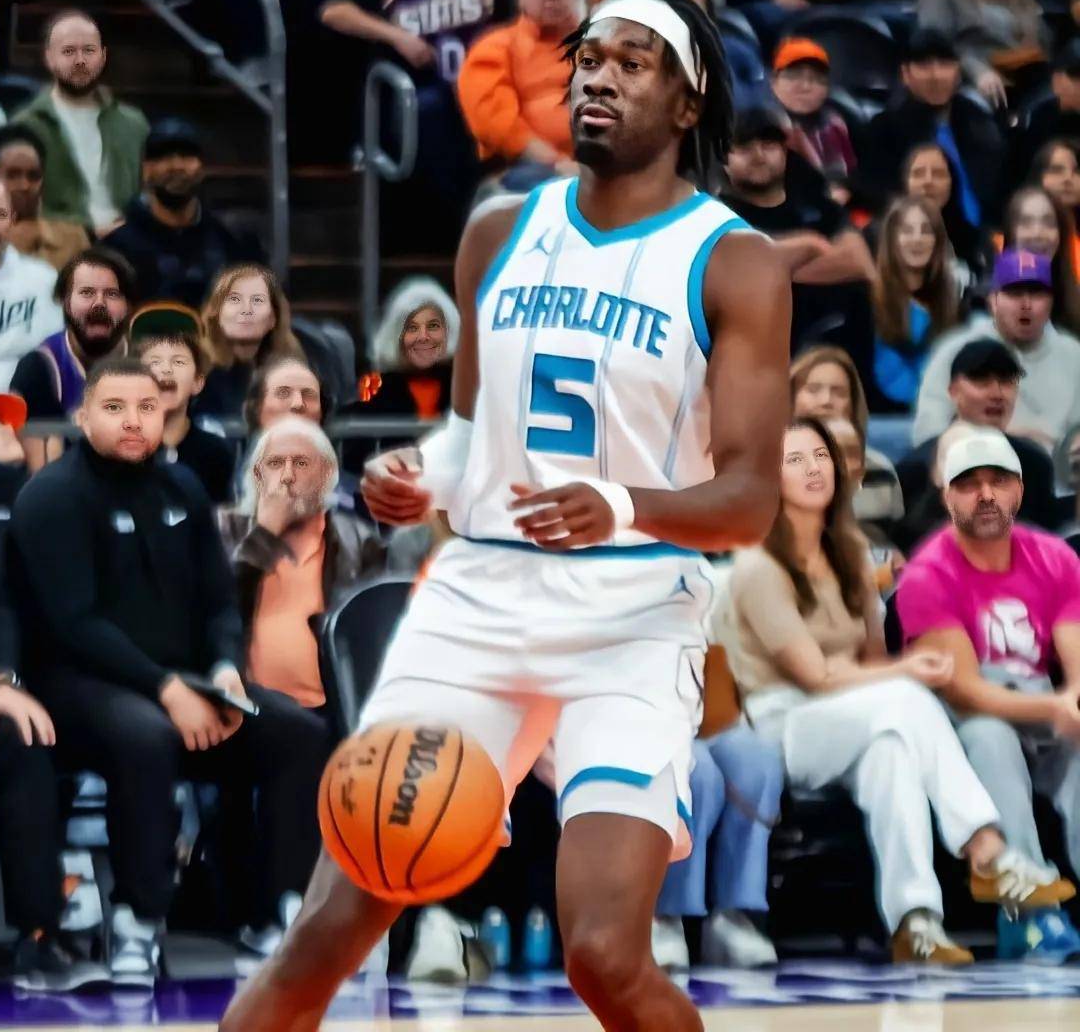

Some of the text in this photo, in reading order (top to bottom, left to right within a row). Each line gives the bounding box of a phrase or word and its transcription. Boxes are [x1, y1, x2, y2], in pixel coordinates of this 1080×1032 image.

[492, 285, 672, 359] CHARLOTTE
[526, 353, 596, 458] 5
[389, 728, 448, 826] Wilson
